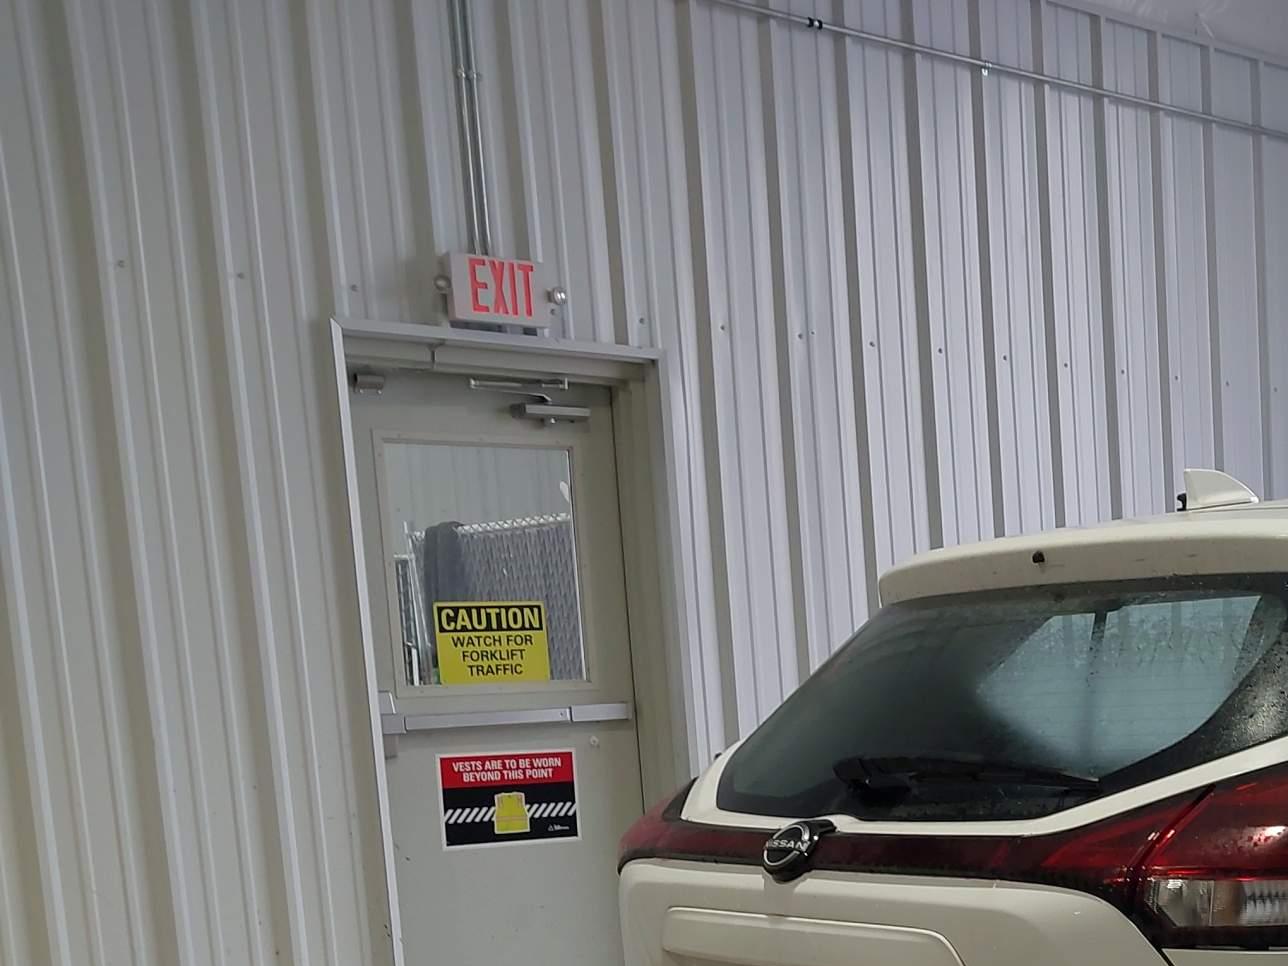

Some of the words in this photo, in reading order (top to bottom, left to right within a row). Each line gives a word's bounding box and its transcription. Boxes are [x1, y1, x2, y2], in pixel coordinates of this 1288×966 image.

[468, 257, 534, 317] EXIT
[440, 607, 540, 631] CAUTION
[451, 635, 502, 648] WATCH
[506, 634, 534, 646] FOR
[462, 649, 526, 662] FORKLIFT
[467, 664, 523, 676] TRAFFIC
[452, 761, 483, 772] VESTS
[484, 760, 503, 770] ARE
[504, 759, 517, 769] TO
[518, 758, 531, 769] BE
[531, 757, 562, 768] WORN
[463, 771, 501, 782] BEYOND
[503, 770, 525, 780] THIS
[526, 768, 553, 779] POINT
